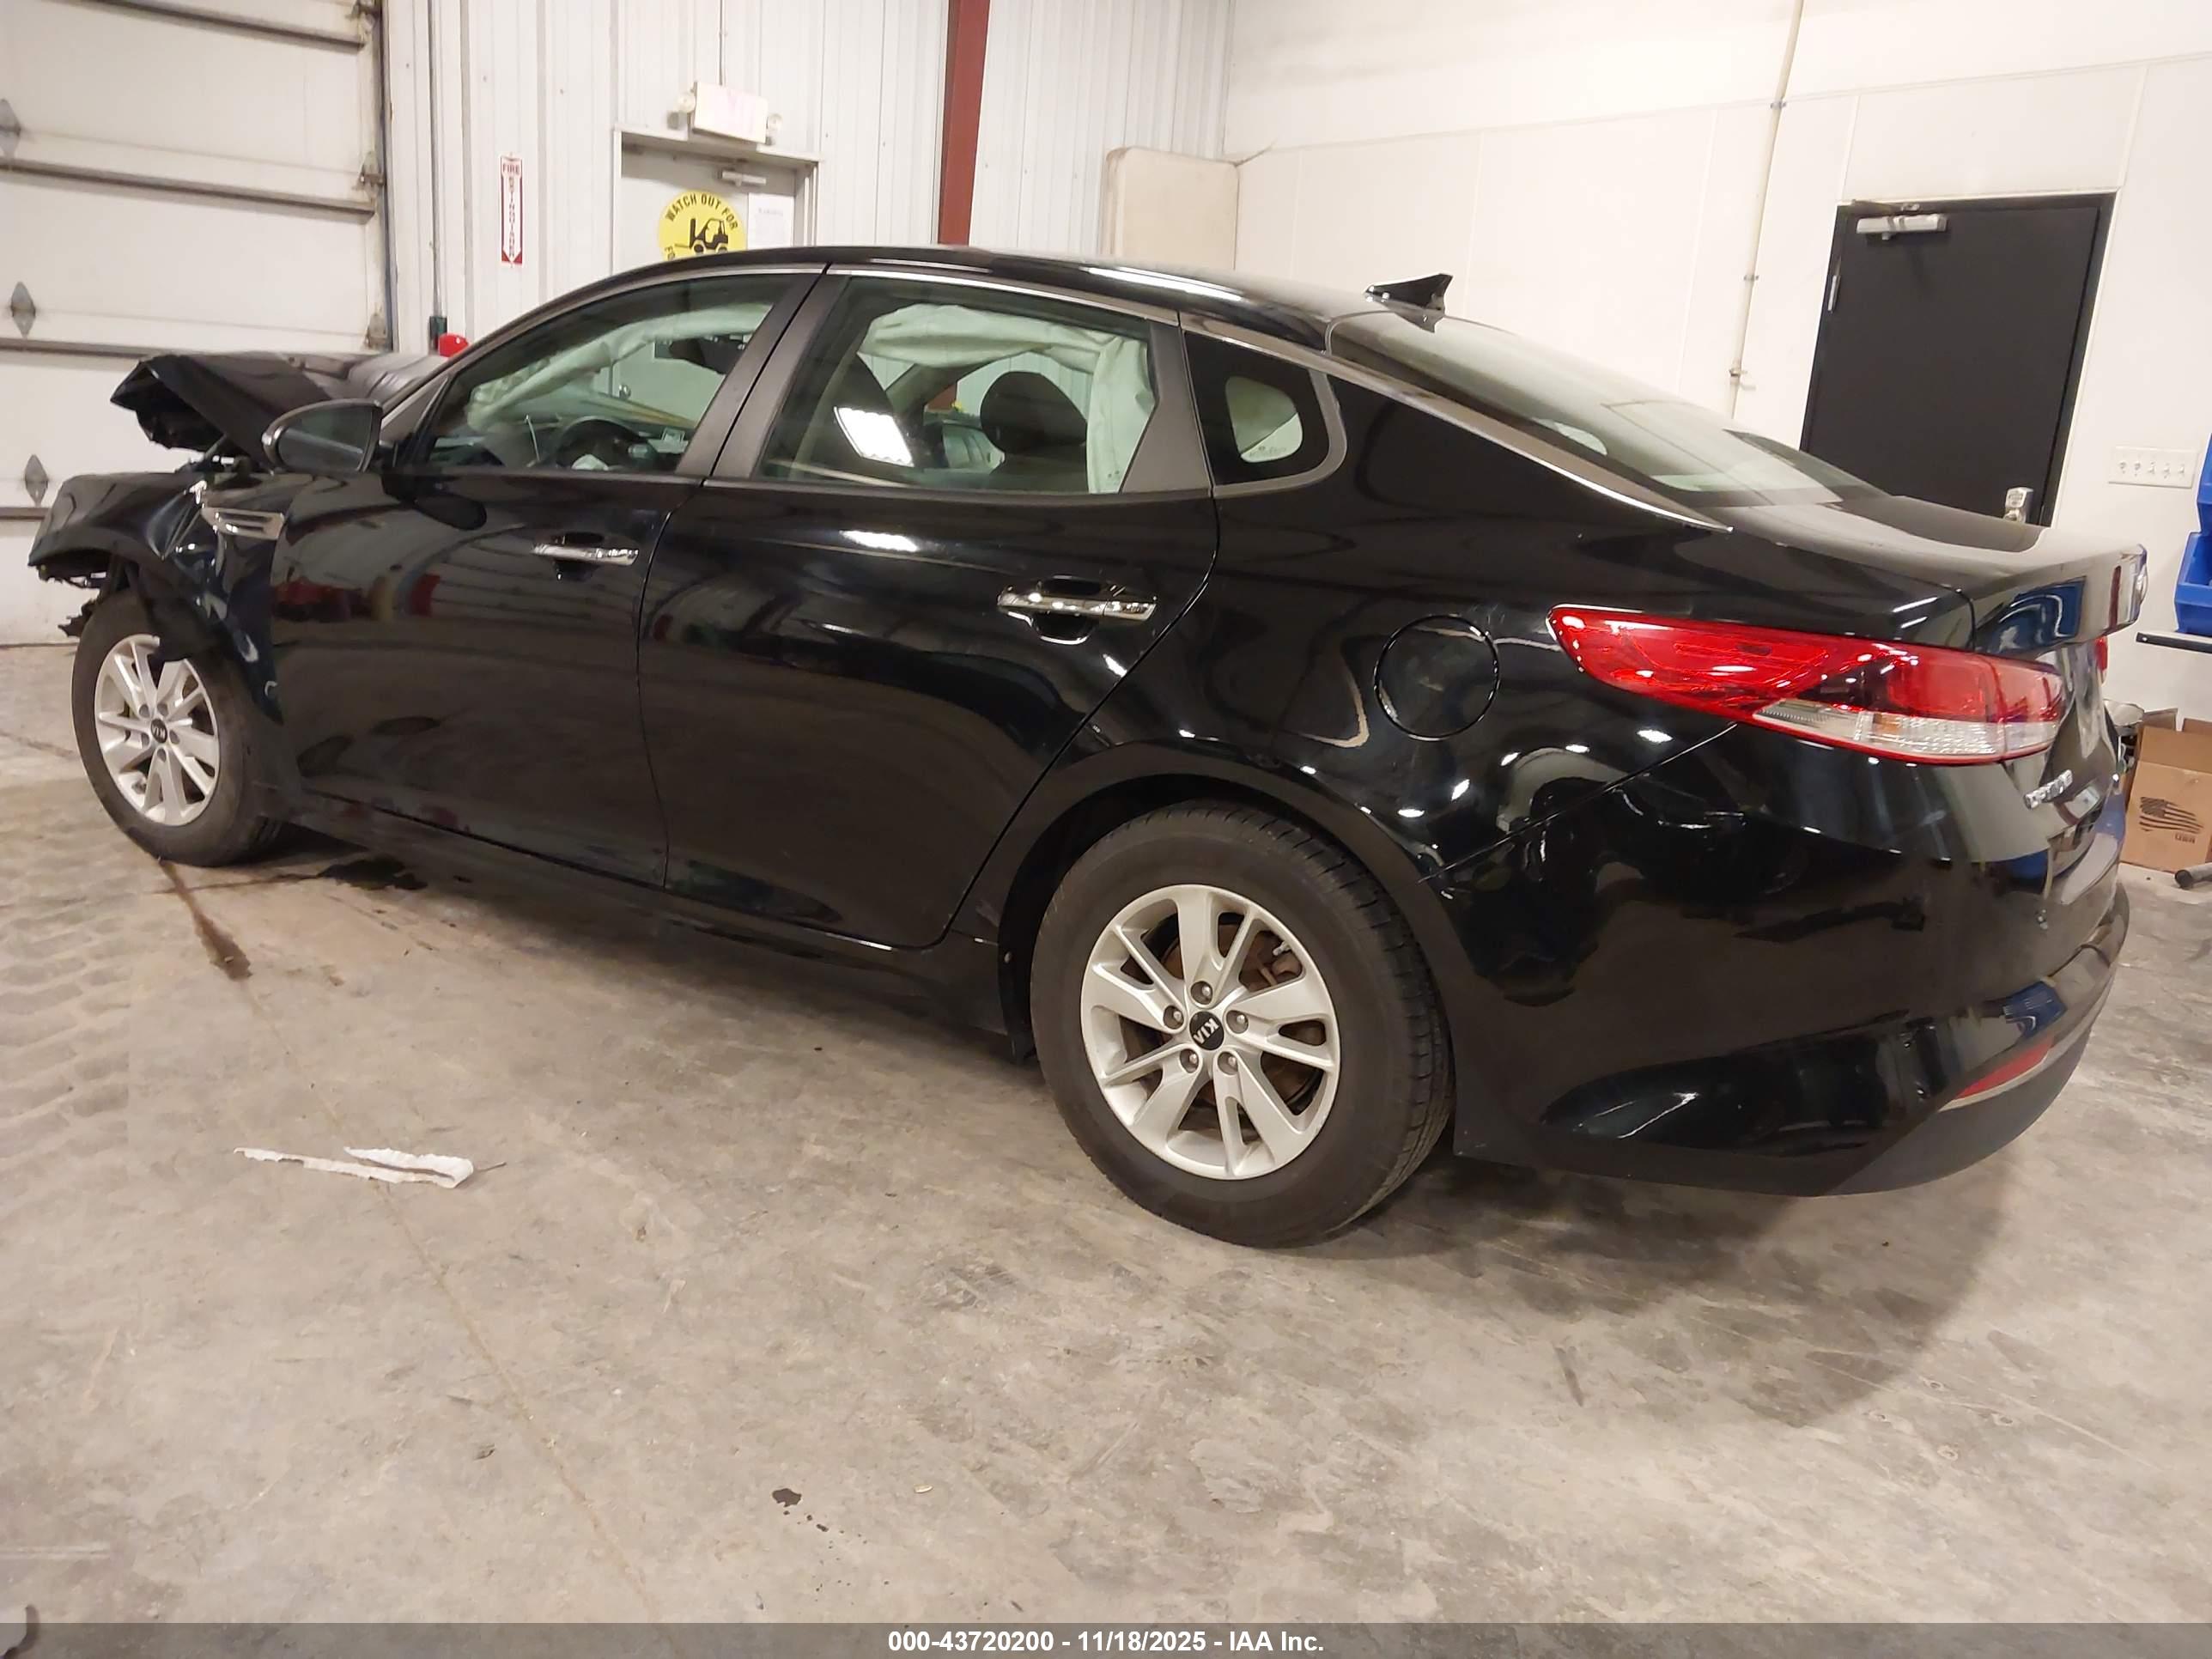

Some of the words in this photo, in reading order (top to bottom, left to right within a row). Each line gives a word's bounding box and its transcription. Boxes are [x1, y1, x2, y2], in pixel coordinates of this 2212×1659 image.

[502, 163, 520, 175] FIRE
[665, 193, 697, 222] WATCH
[701, 193, 722, 210] OUT
[721, 207, 738, 231] FOR
[1193, 1018, 1220, 1045] KIA
